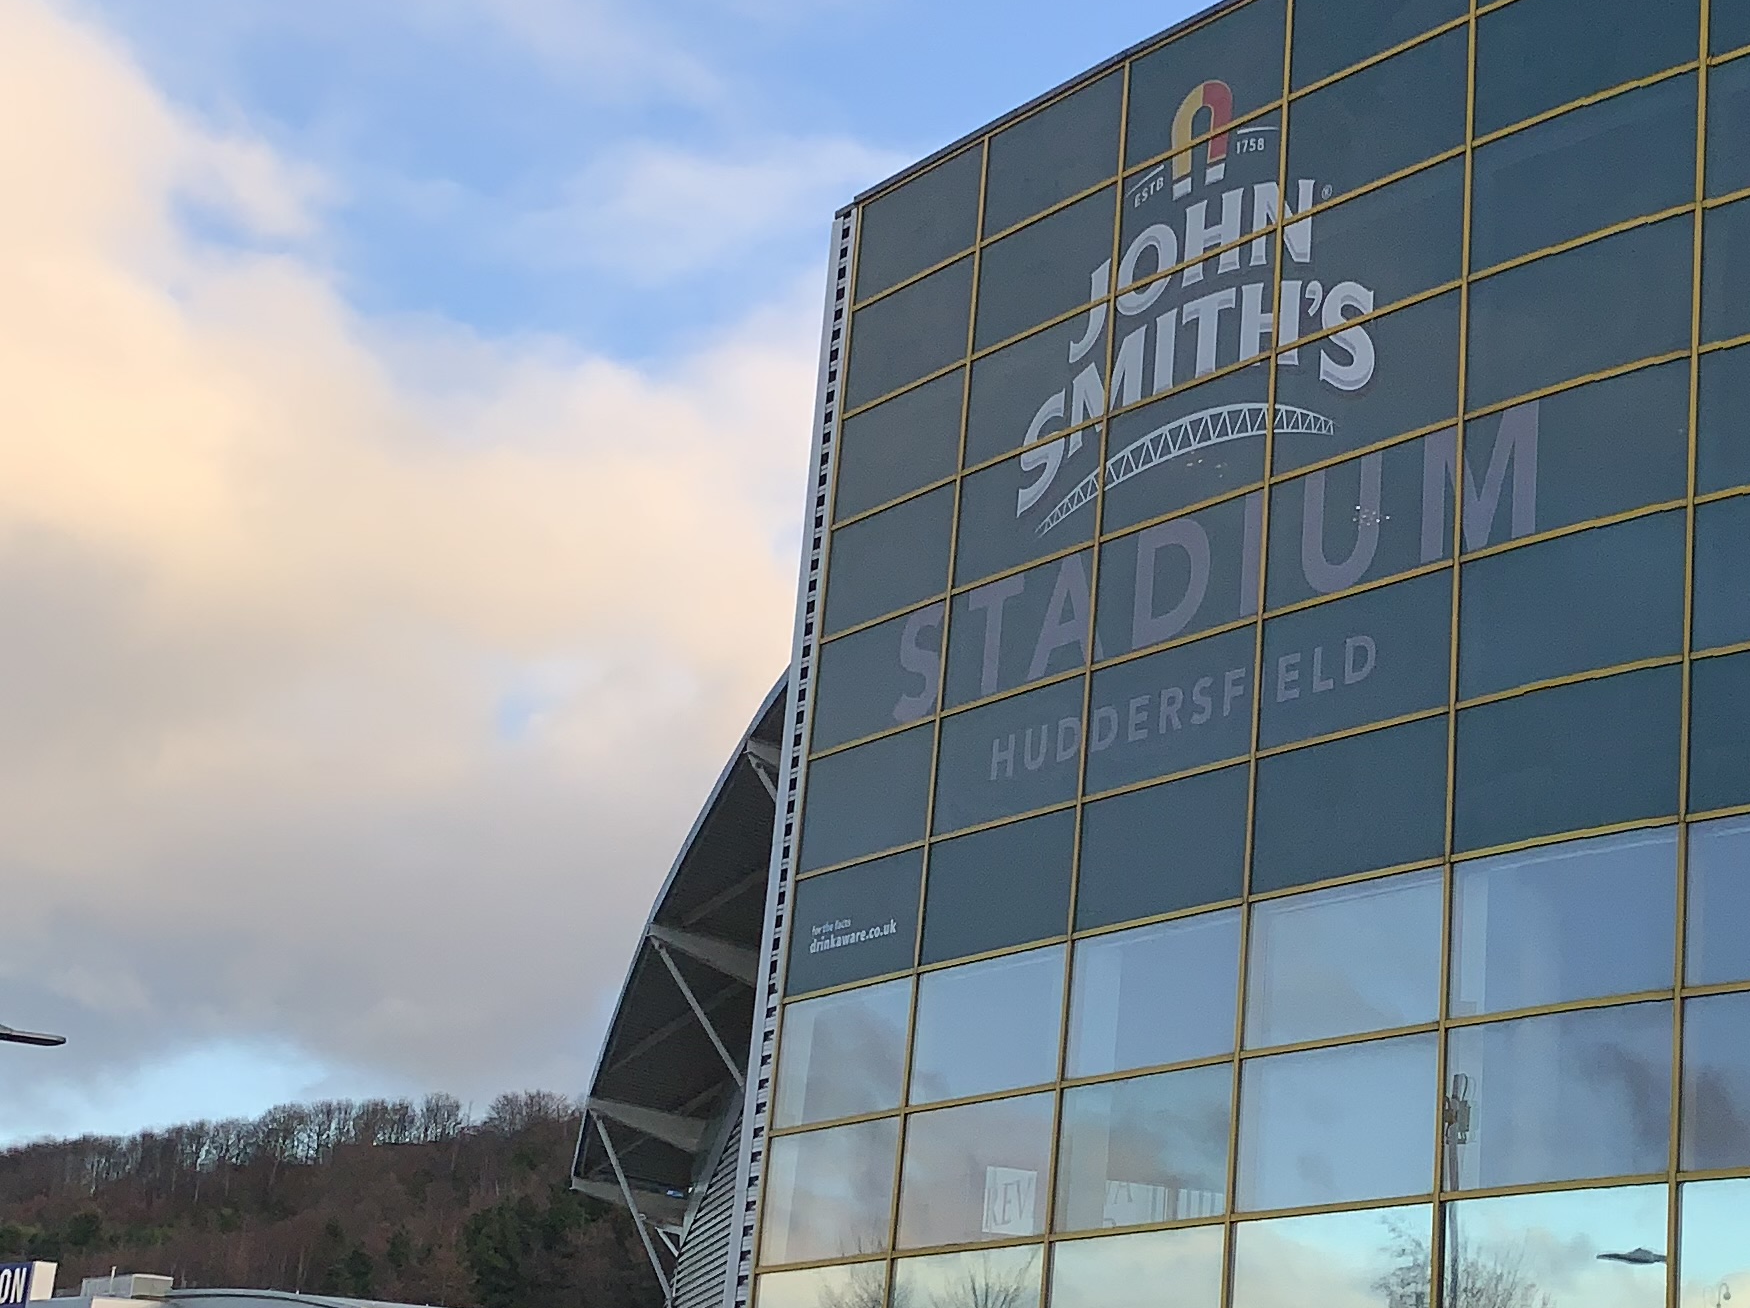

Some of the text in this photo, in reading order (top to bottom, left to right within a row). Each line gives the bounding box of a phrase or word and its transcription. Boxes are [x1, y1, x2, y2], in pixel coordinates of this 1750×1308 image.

[1134, 177, 1164, 208] ESTB
[1236, 138, 1265, 154] 1758
[1068, 178, 1316, 364] JOHN
[1015, 278, 1377, 518] SMITH'S
[893, 399, 1541, 723] STADIUM
[989, 634, 1378, 782] HUDDERSFELD
[809, 918, 897, 954] drinkaware.co.uk
